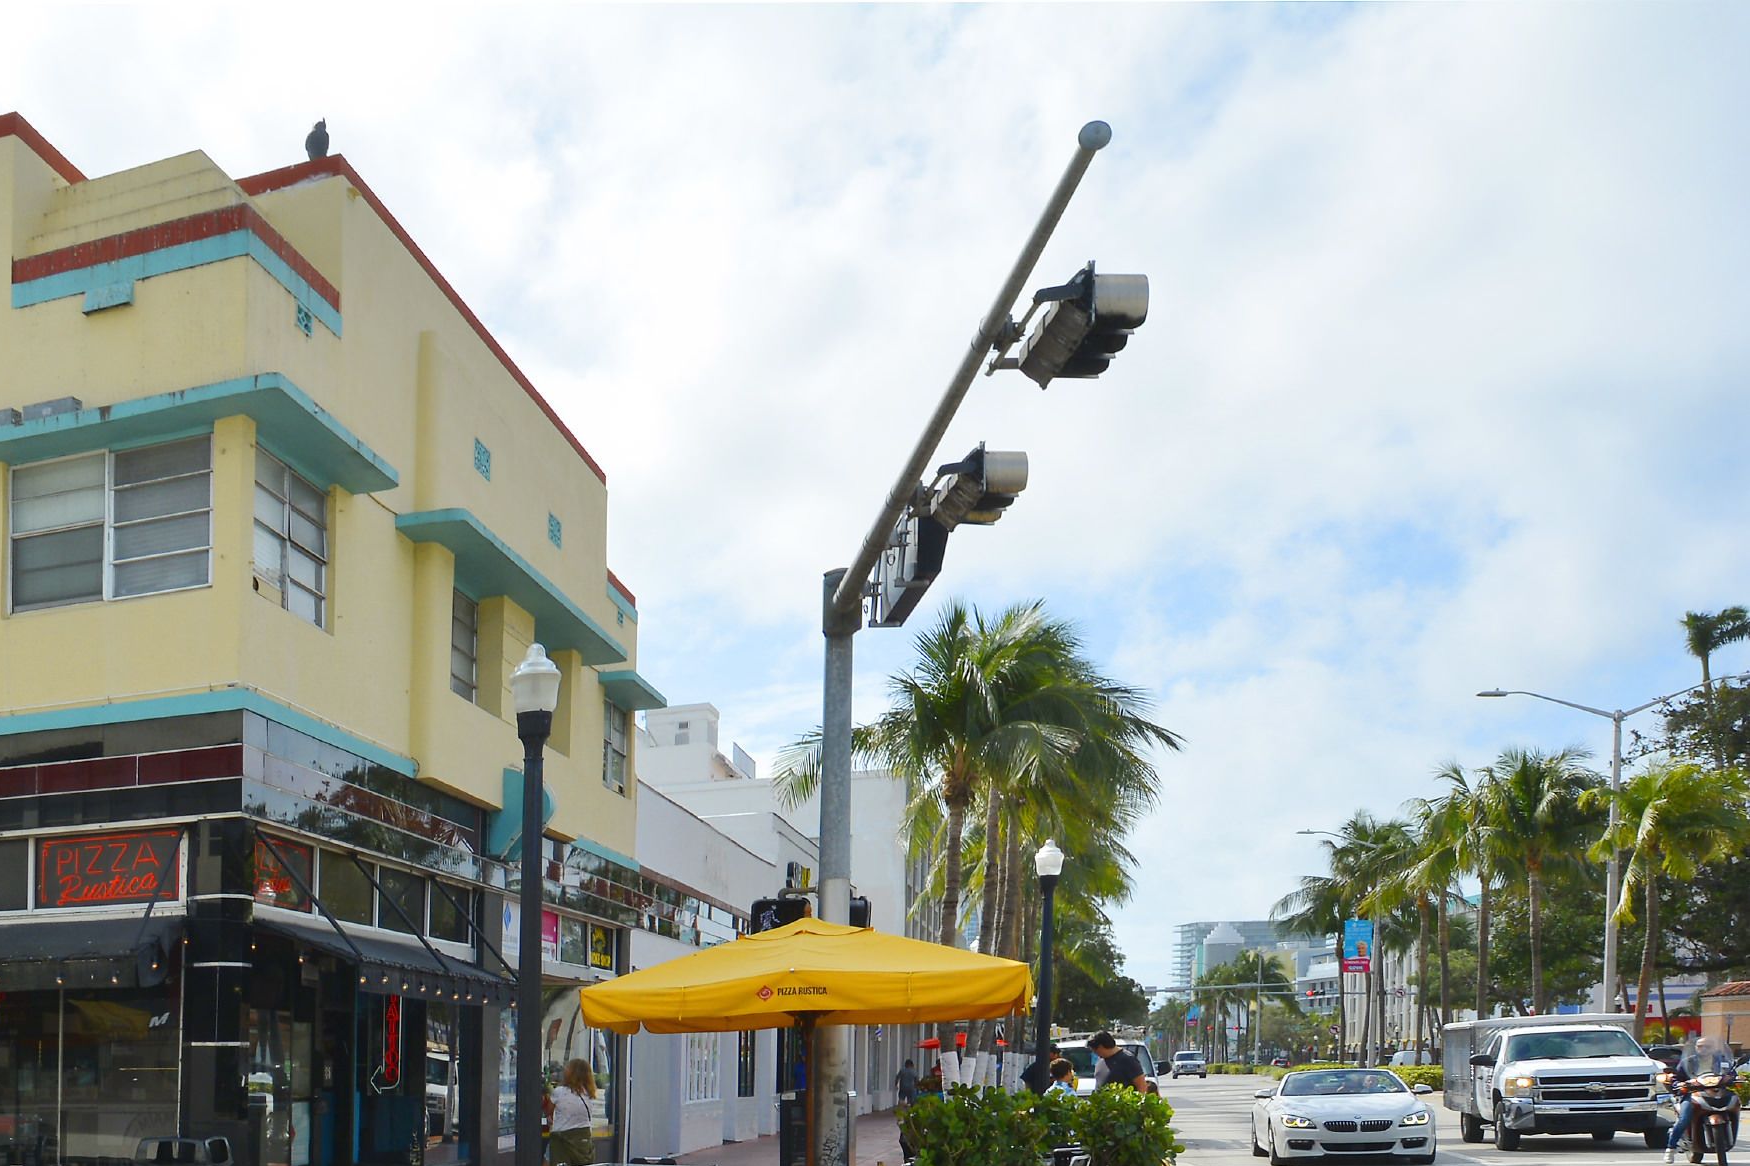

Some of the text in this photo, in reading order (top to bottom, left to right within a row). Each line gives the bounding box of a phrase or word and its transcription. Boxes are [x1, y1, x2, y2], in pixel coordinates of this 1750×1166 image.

[56, 841, 161, 876] PIZZA
[57, 872, 159, 906] Rustica
[777, 986, 827, 996] PIZZA RUSTICA
